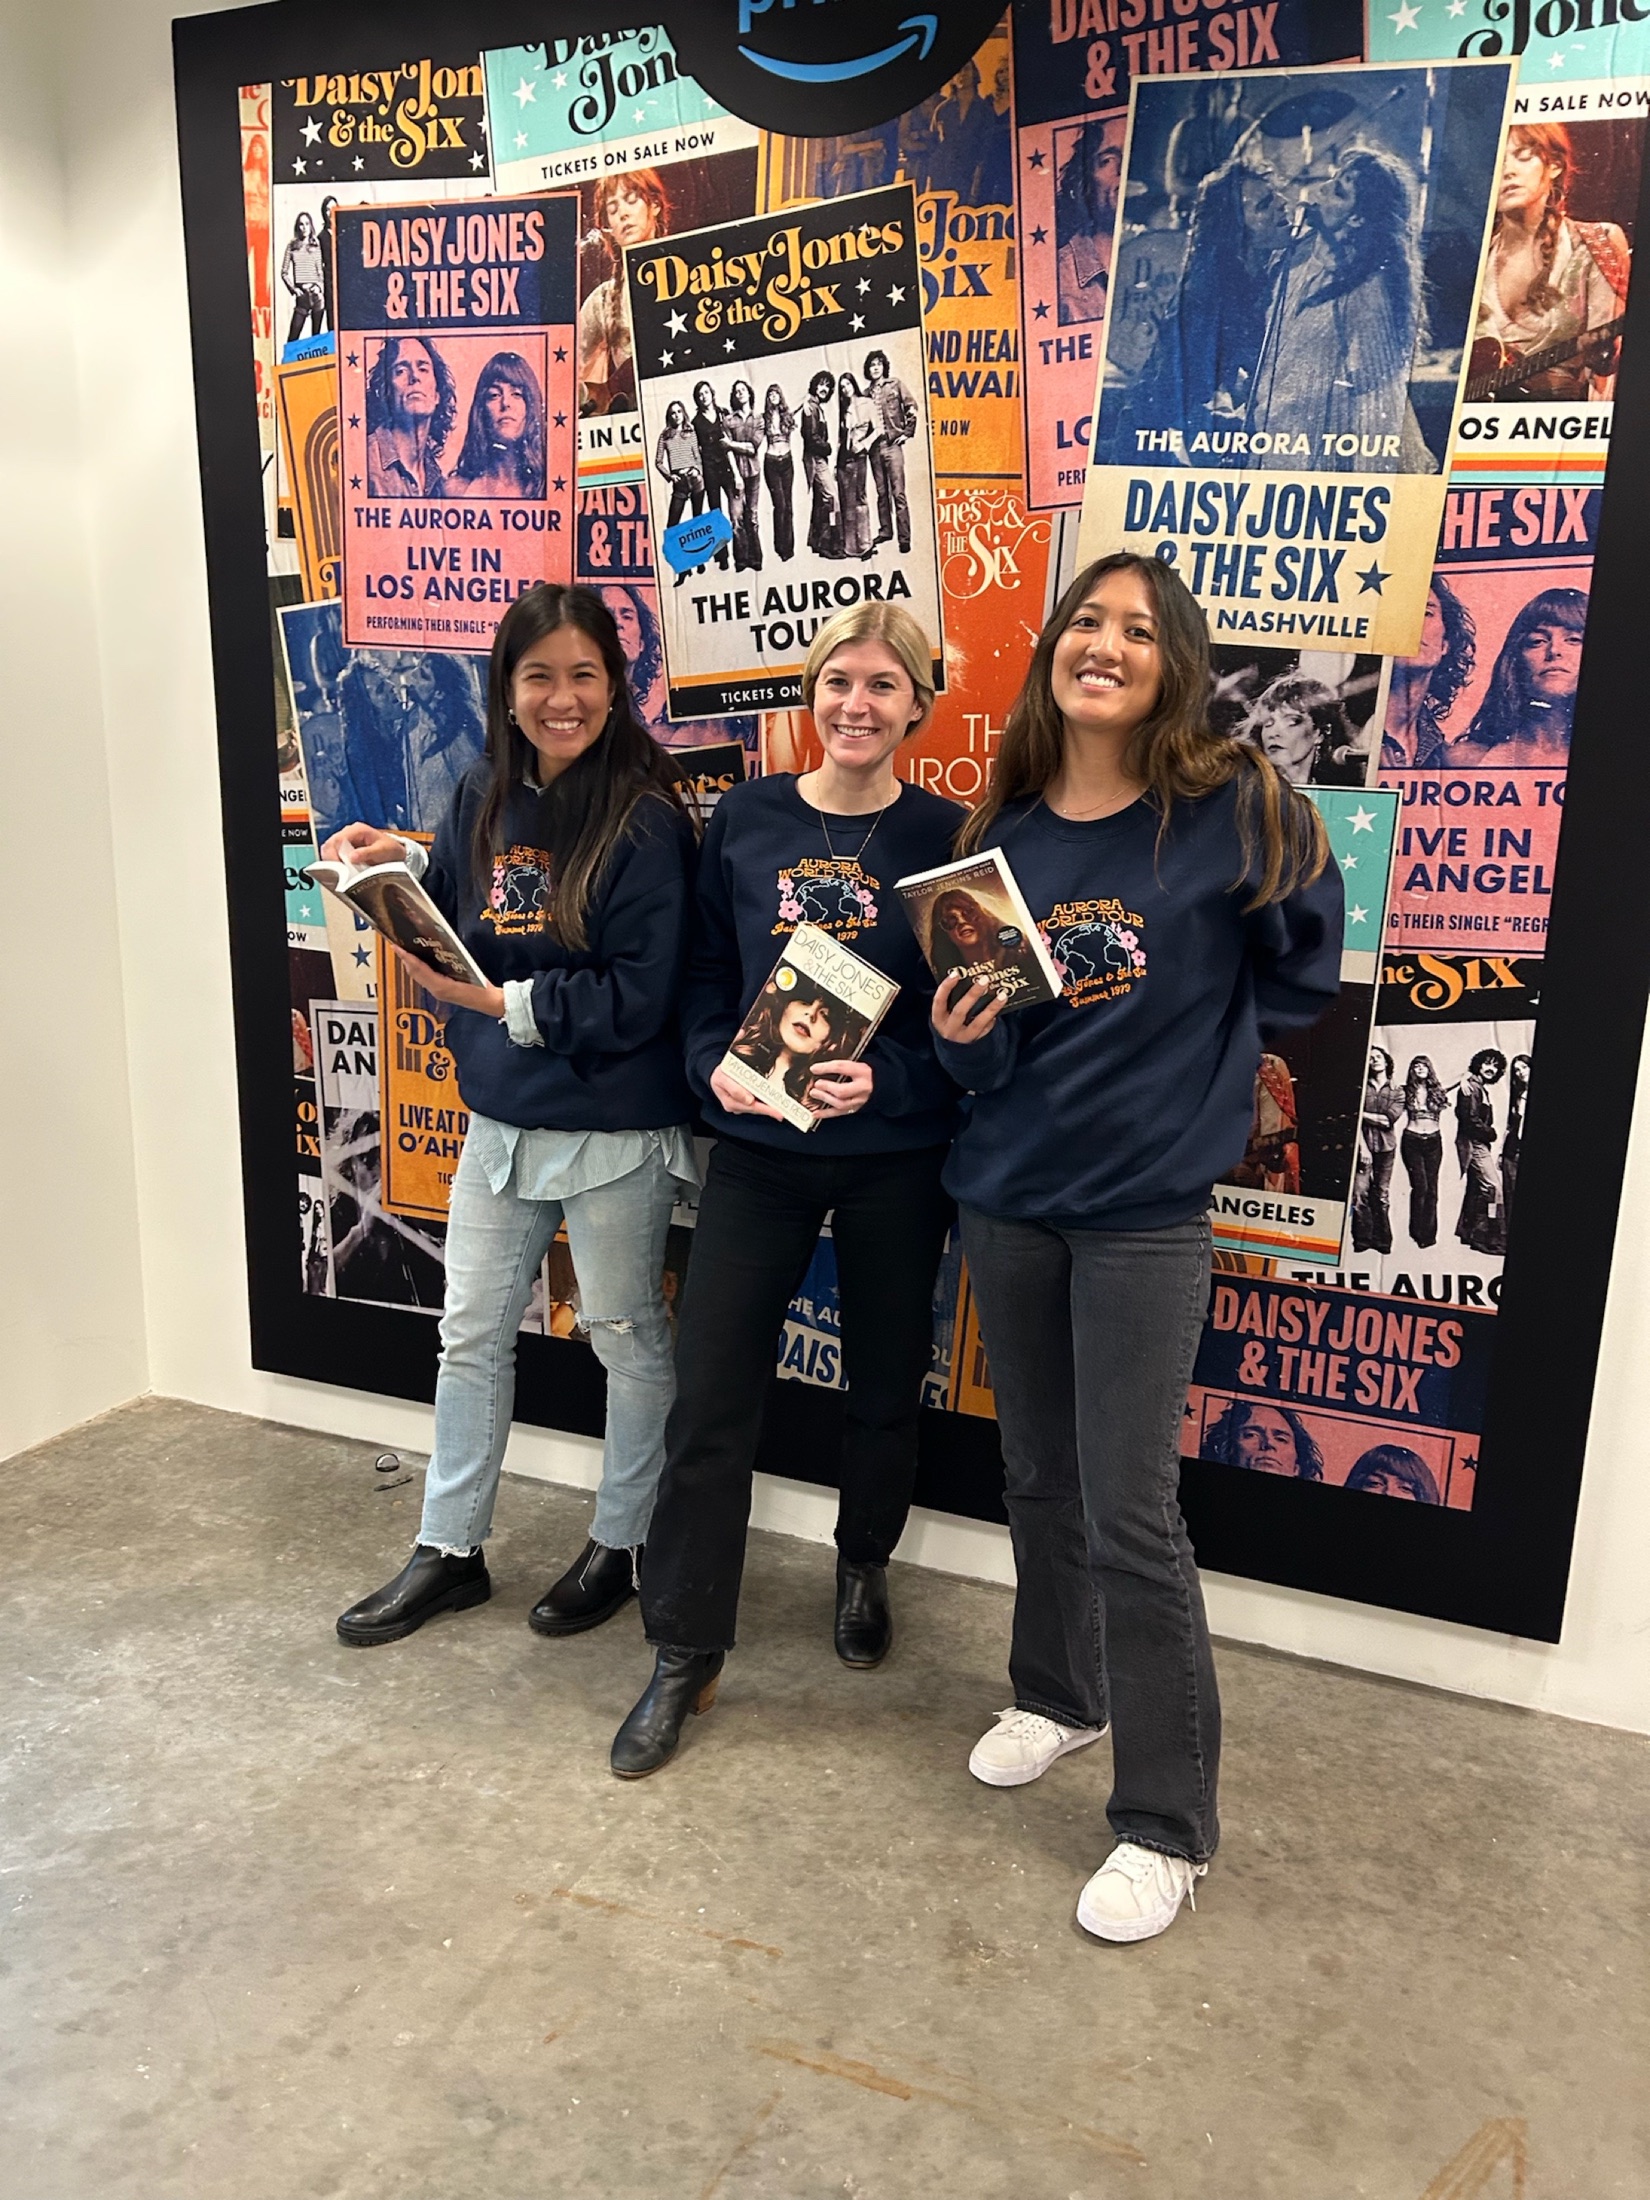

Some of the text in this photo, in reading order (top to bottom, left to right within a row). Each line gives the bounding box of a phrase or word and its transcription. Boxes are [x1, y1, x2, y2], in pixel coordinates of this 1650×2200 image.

[1084, 2, 1281, 99] & THE SIX
[281, 70, 402, 115] Daisy
[1539, 94, 1588, 112] SALE
[328, 99, 467, 168] & the Six
[541, 131, 715, 180] TICKETS ON SALE NOW
[362, 210, 545, 269] DAISY JONES
[637, 219, 904, 303] Daisy Jones
[386, 267, 520, 320] & THE SIX
[694, 276, 845, 342] & the Six
[1038, 333, 1093, 365] THE
[590, 427, 612, 449] IN
[940, 420, 971, 436] NOW
[1135, 429, 1401, 457] THE AURORA TOUR
[354, 507, 561, 532] THE AURORA TOUR
[1124, 479, 1391, 544] DAISY JONES
[1509, 488, 1592, 547] SIX
[588, 520, 611, 568] &
[678, 524, 713, 548] prime
[407, 547, 502, 573] LIVE IN
[942, 519, 1052, 599] Six
[1190, 542, 1268, 599] THE
[1271, 546, 1347, 603] SIX
[366, 574, 414, 600] LOS
[692, 569, 912, 625] THE AURORA
[367, 616, 423, 631] PERFORMING
[426, 619, 451, 633] THEIR
[454, 620, 486, 634] SINGLE
[1216, 608, 1369, 639] NASHVILLE
[721, 686, 801, 705] TICKETS ON
[1484, 828, 1532, 858] IN
[777, 867, 880, 891] WORLD TOUR
[797, 858, 862, 872] AURORA
[902, 886, 934, 899] TAYLOR
[936, 874, 972, 891] JENKINS
[973, 866, 994, 878] REID
[1051, 898, 1123, 917] AURORA
[1097, 910, 1145, 928] TOUR
[1403, 913, 1444, 930] THEIR
[1449, 914, 1499, 932] SINGLE
[837, 930, 858, 941] 1979
[794, 929, 836, 964] DAISY
[832, 959, 884, 1000] JONES
[813, 963, 837, 988] THE
[834, 980, 857, 1002] SIX
[1110, 982, 1132, 997] 1979
[1410, 953, 1526, 1011] Six
[425, 1051, 450, 1082] &
[400, 1104, 433, 1130] LIVE
[436, 1109, 456, 1133] AT
[1210, 1193, 1315, 1226] ANGELES
[1213, 1285, 1464, 1369] DAISY JONES
[1237, 1340, 1424, 1414] & THE SIX
